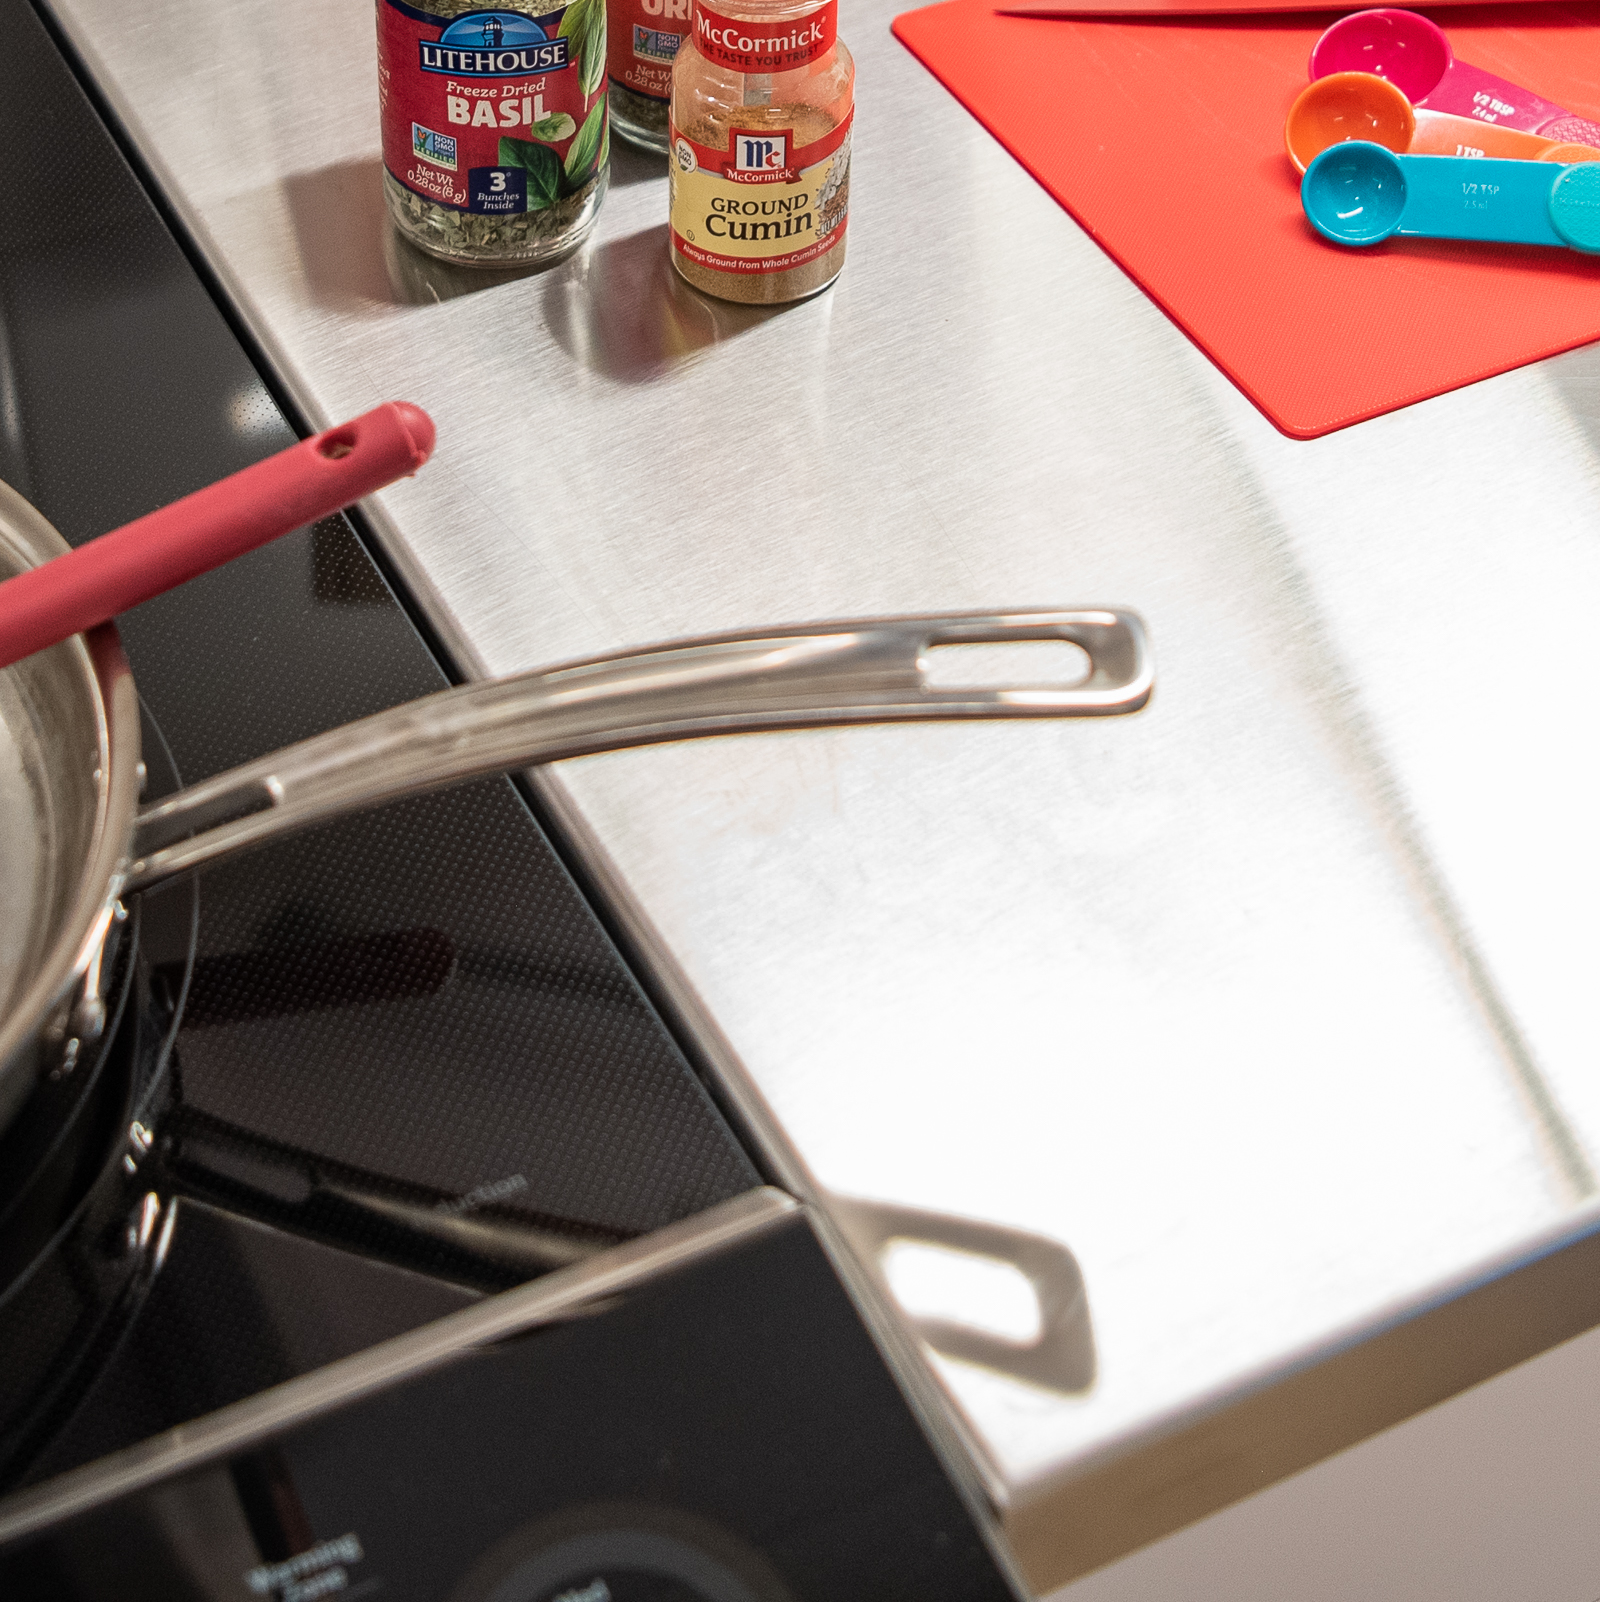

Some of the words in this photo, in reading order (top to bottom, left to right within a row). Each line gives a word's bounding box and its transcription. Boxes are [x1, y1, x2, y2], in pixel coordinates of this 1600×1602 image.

[657, 39, 679, 49] GMO
[658, 32, 679, 43] NON
[423, 44, 566, 72] LITEHOUSE
[716, 48, 751, 67] TASTE
[756, 54, 782, 66] YOU
[786, 44, 819, 63] TRUST
[625, 70, 648, 87] 0.28
[650, 80, 663, 92] oz
[636, 64, 656, 80] Net
[446, 80, 498, 98] Freeze
[501, 77, 547, 97] Dried
[447, 94, 552, 128] BASIL
[434, 134, 454, 146] NON
[434, 141, 455, 153] GMO
[414, 143, 455, 165] VERIFIED
[1463, 145, 1485, 158] TSP
[417, 164, 436, 180] Net
[436, 172, 455, 187] Wt
[726, 168, 794, 183] McCormick
[407, 169, 429, 189] 0.28
[428, 182, 442, 194] oz
[442, 184, 454, 199] (8
[453, 188, 467, 204] g)
[477, 192, 520, 202] Bunches
[1461, 182, 1478, 195] 1/2
[1480, 184, 1500, 195] TSP
[483, 200, 515, 210] Inside
[710, 193, 809, 216] GROUND
[705, 212, 813, 241] Cumin
[683, 243, 706, 262] Always
[706, 254, 737, 269] Ground
[738, 260, 760, 269] from
[762, 257, 789, 269] Whole
[790, 247, 817, 263] Cumin
[817, 235, 836, 251] Seeds
